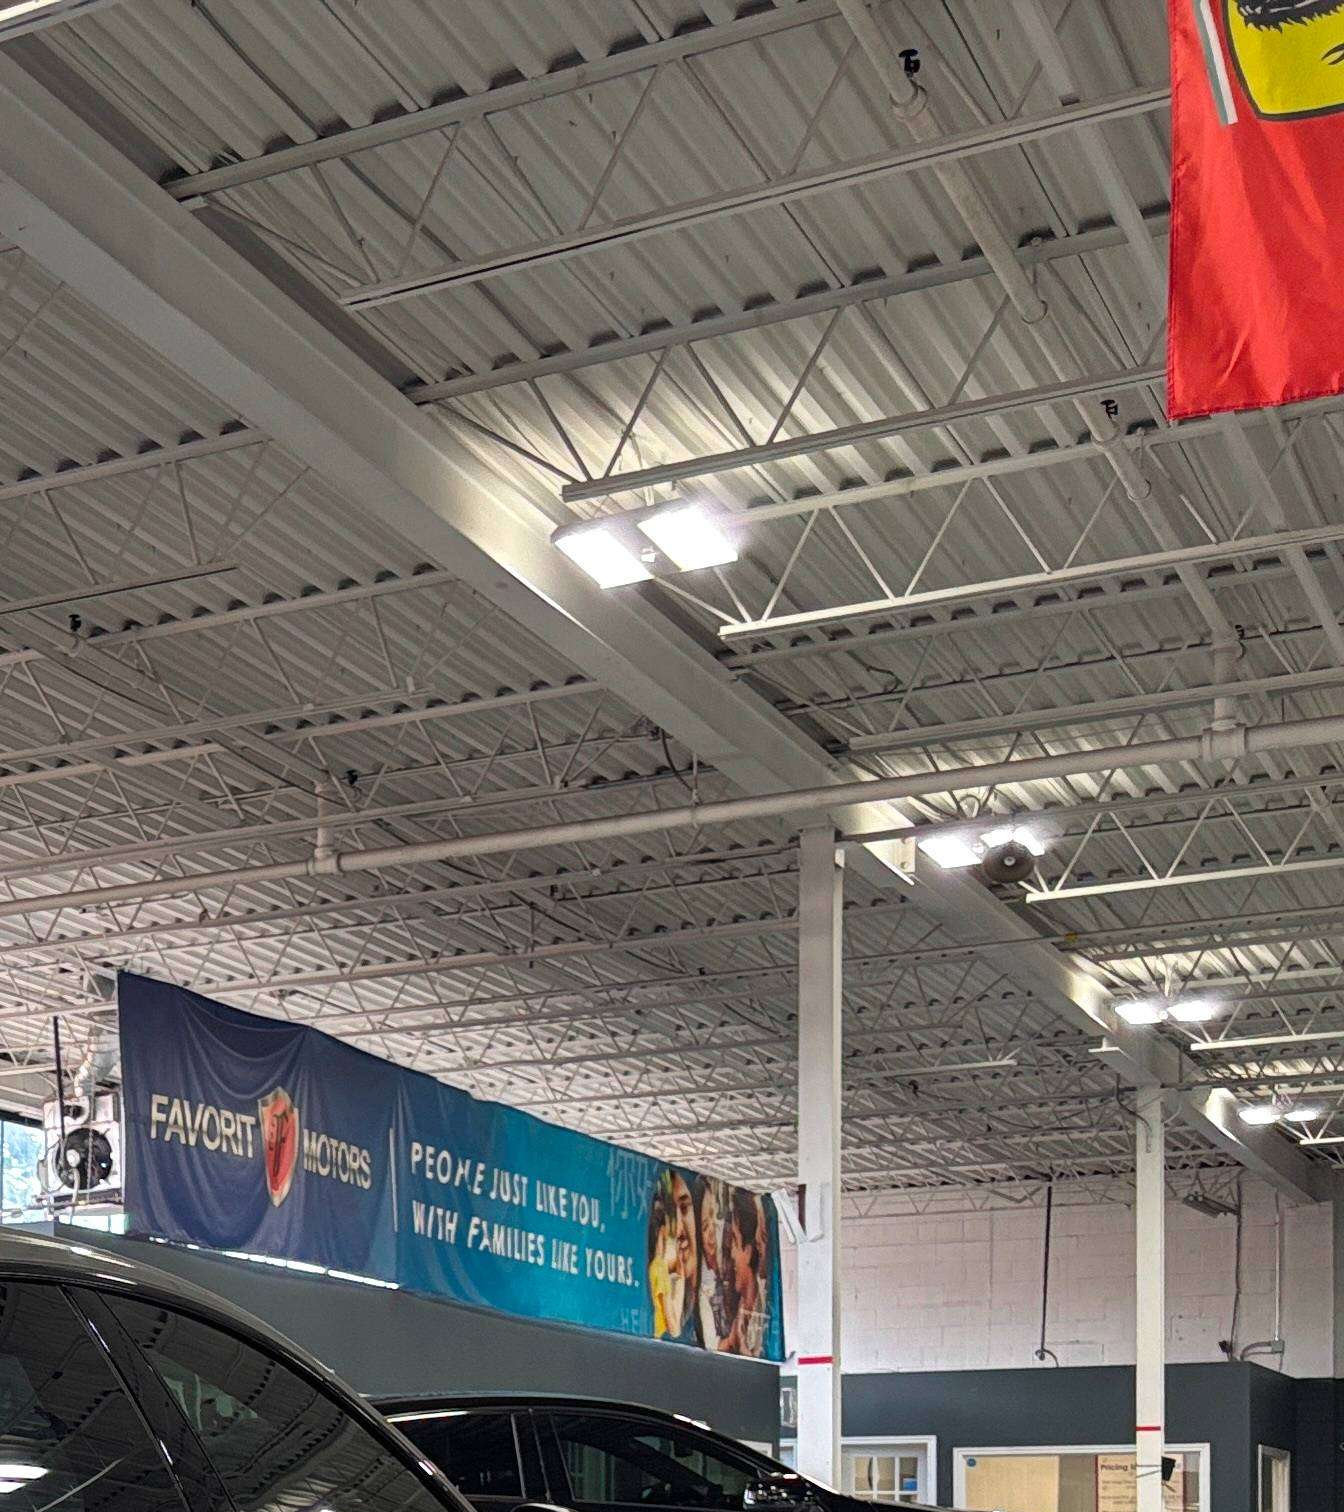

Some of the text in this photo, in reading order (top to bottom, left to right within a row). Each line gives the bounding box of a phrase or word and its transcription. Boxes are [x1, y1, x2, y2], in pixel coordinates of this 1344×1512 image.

[150, 1094, 372, 1190] FAVORIT MOTORS
[412, 1200, 639, 1287] WITH FAMILIES LIKE YOURS.
[490, 1168, 528, 1207] JUST
[536, 1180, 567, 1219] LIKE
[571, 1191, 605, 1233] YOU,
